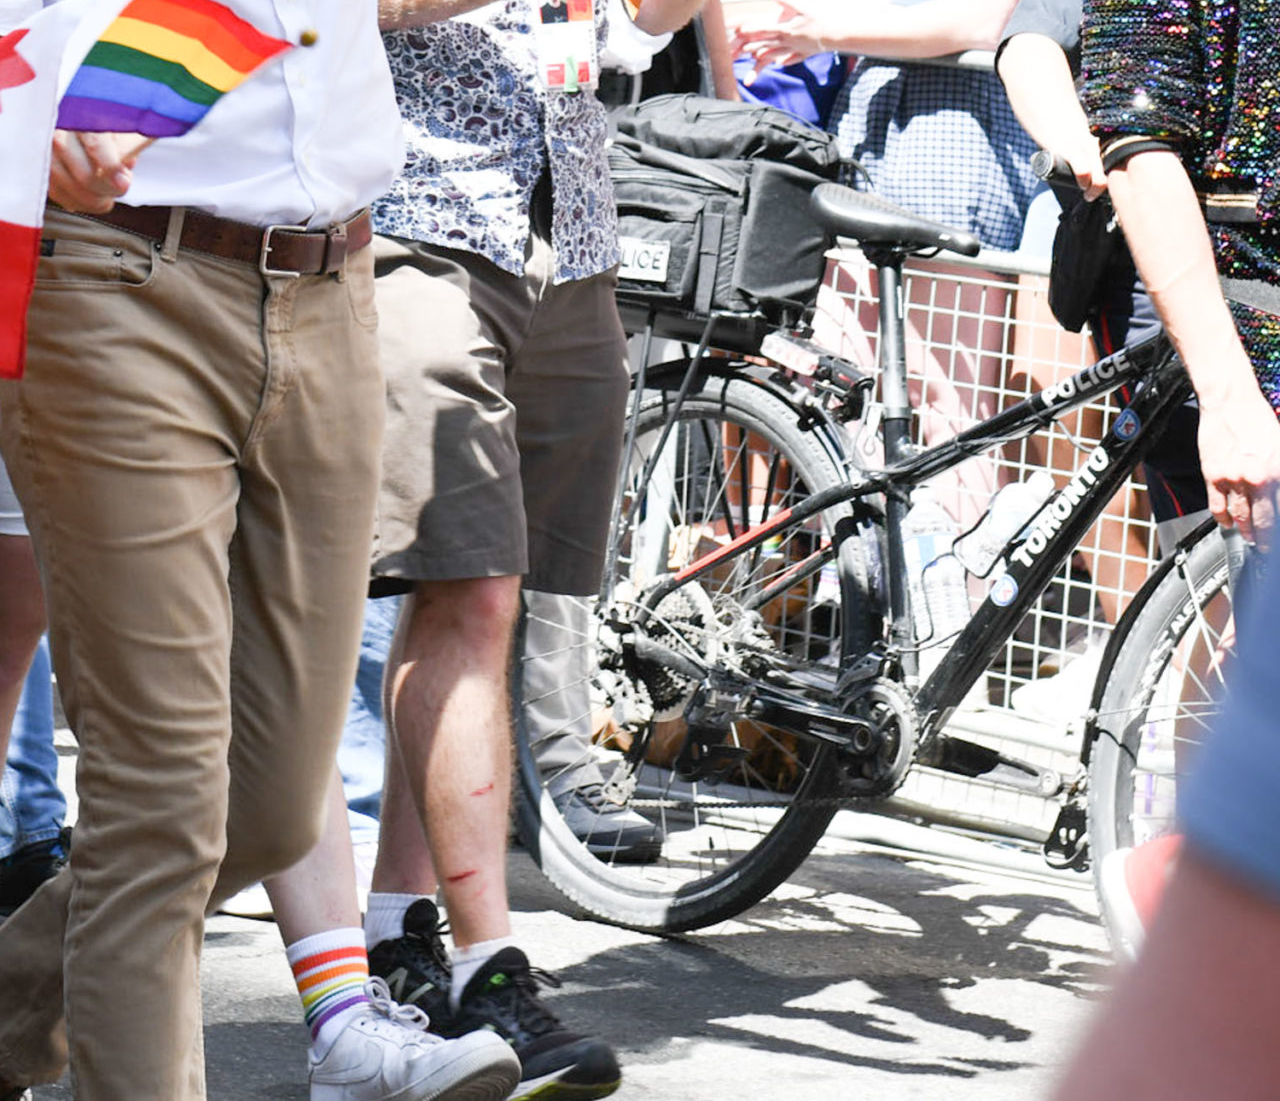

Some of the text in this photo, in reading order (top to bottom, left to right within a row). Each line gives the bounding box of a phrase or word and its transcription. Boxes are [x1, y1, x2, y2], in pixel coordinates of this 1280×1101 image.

[620, 248, 665, 271] LICE
[1041, 353, 1131, 408] POLICE
[1010, 446, 1109, 568] TORONTO
